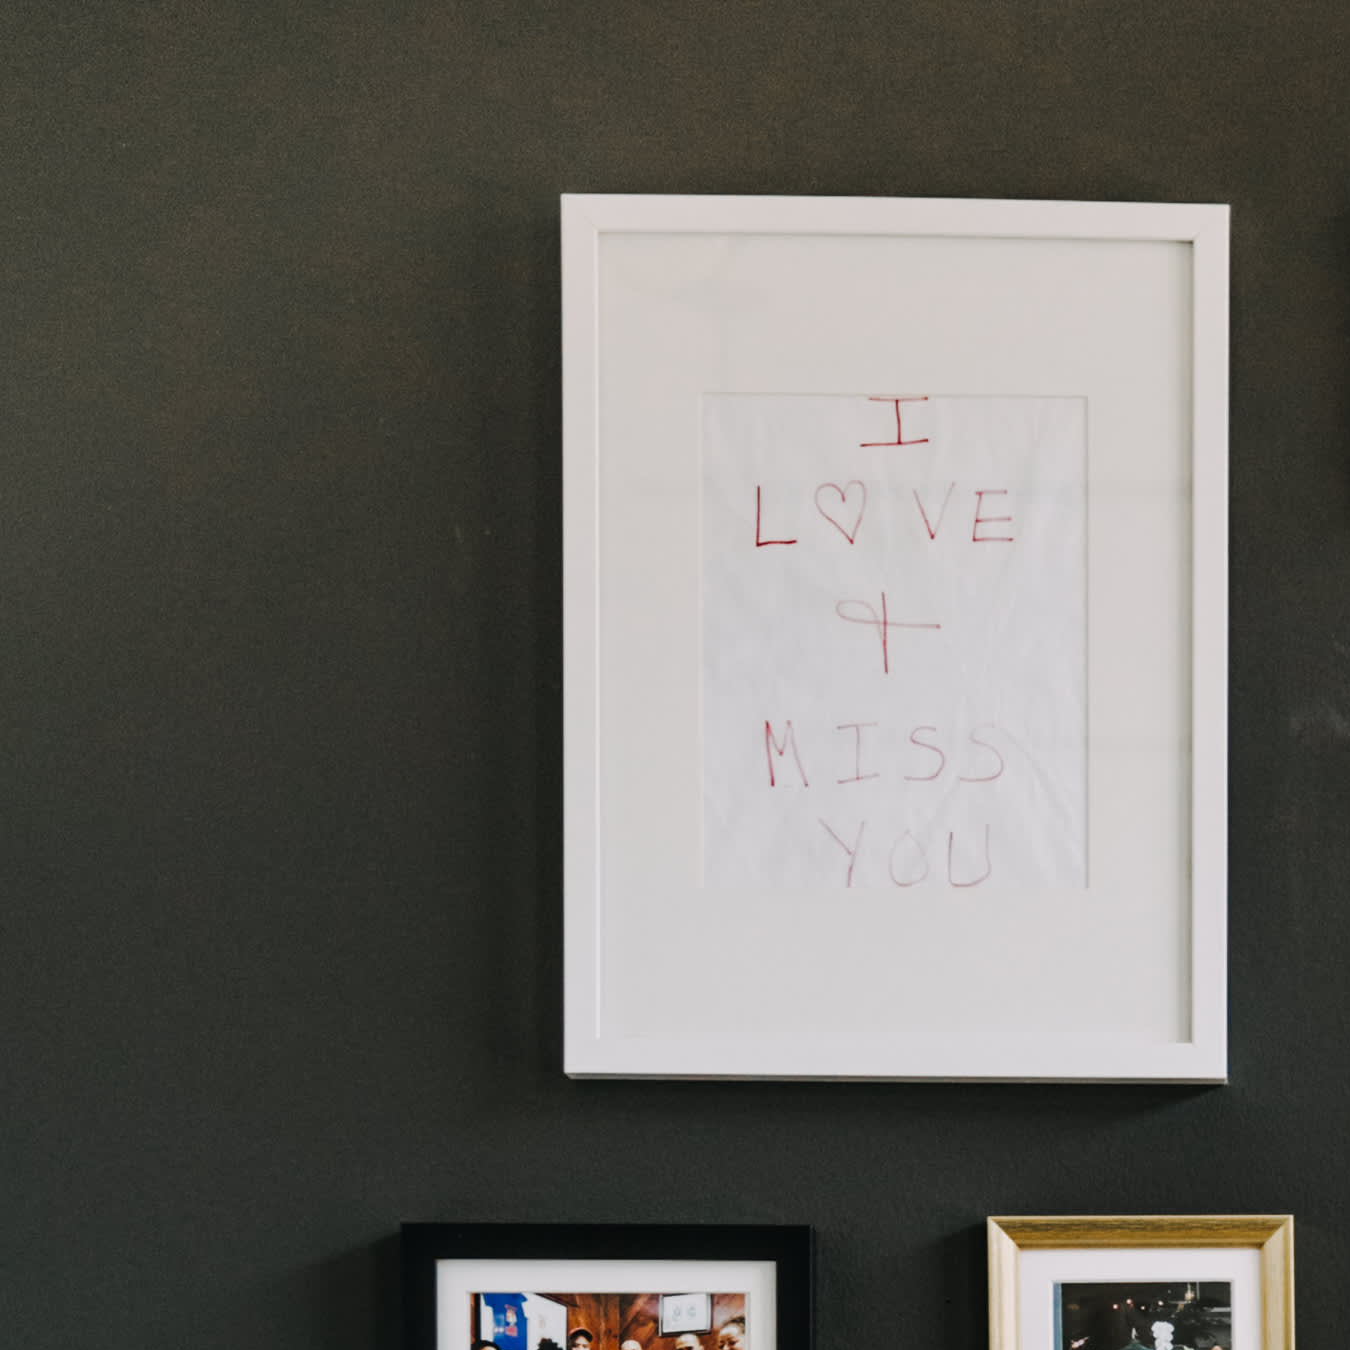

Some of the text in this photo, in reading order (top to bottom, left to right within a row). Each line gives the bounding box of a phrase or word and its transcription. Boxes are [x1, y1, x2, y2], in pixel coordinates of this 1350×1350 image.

[859, 395, 930, 449] I
[764, 719, 1005, 788] MISS
[819, 819, 993, 889] YOU
